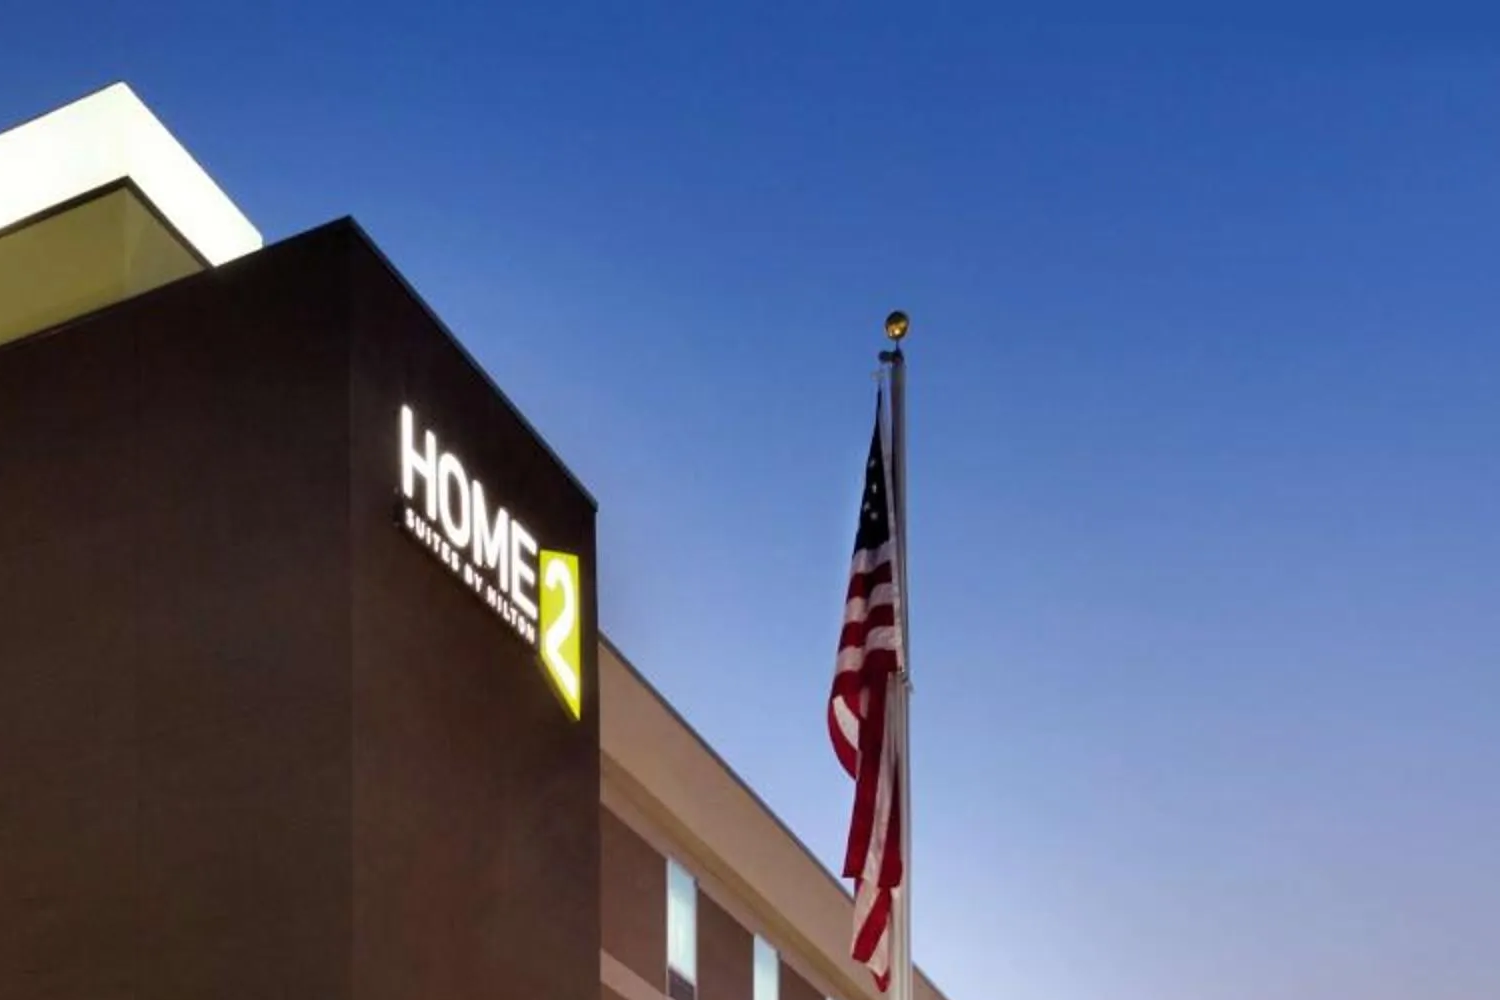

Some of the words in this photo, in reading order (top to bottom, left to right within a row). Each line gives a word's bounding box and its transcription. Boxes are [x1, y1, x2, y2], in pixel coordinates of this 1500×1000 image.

[405, 507, 460, 572] SUITES
[464, 563, 483, 593] BY
[486, 585, 536, 645] HILTON
